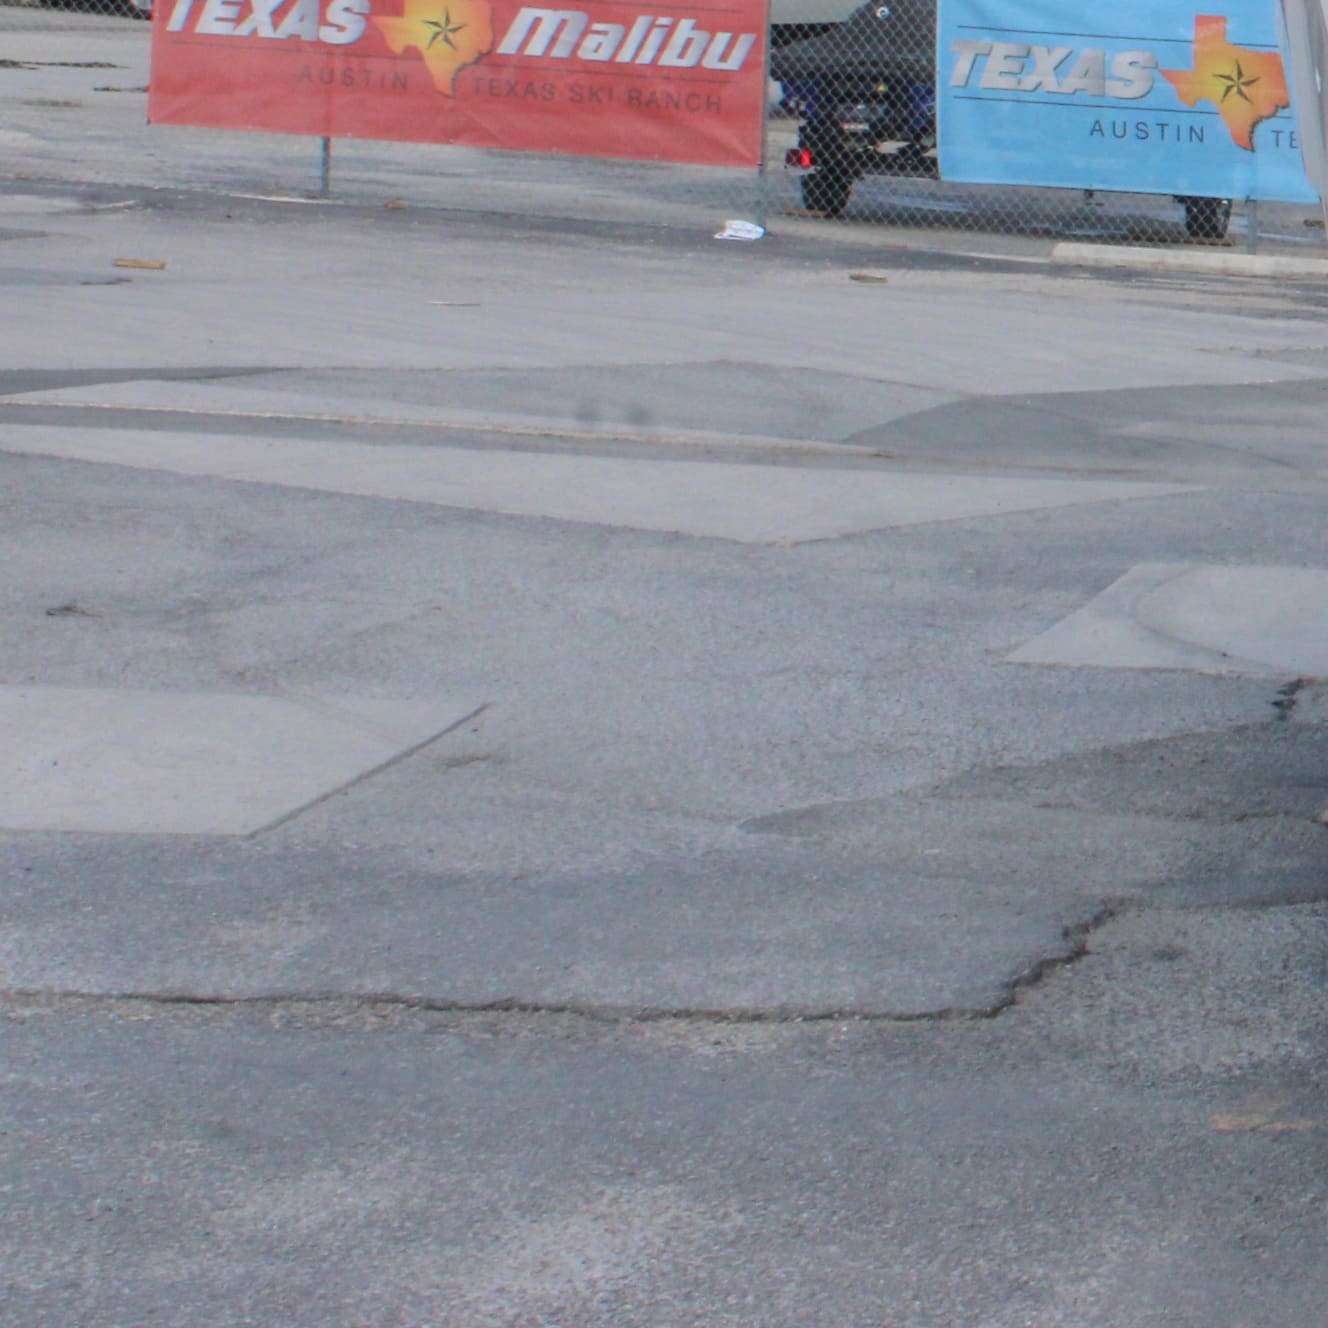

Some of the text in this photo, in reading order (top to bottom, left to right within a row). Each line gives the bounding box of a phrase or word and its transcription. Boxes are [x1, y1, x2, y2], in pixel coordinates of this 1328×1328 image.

[496, 6, 757, 72] Malibu
[298, 63, 722, 114] AUSTIN TEXAS SKI RANCH
[948, 38, 1160, 101] TEXAS
[1088, 119, 1206, 144] AUSTIN
